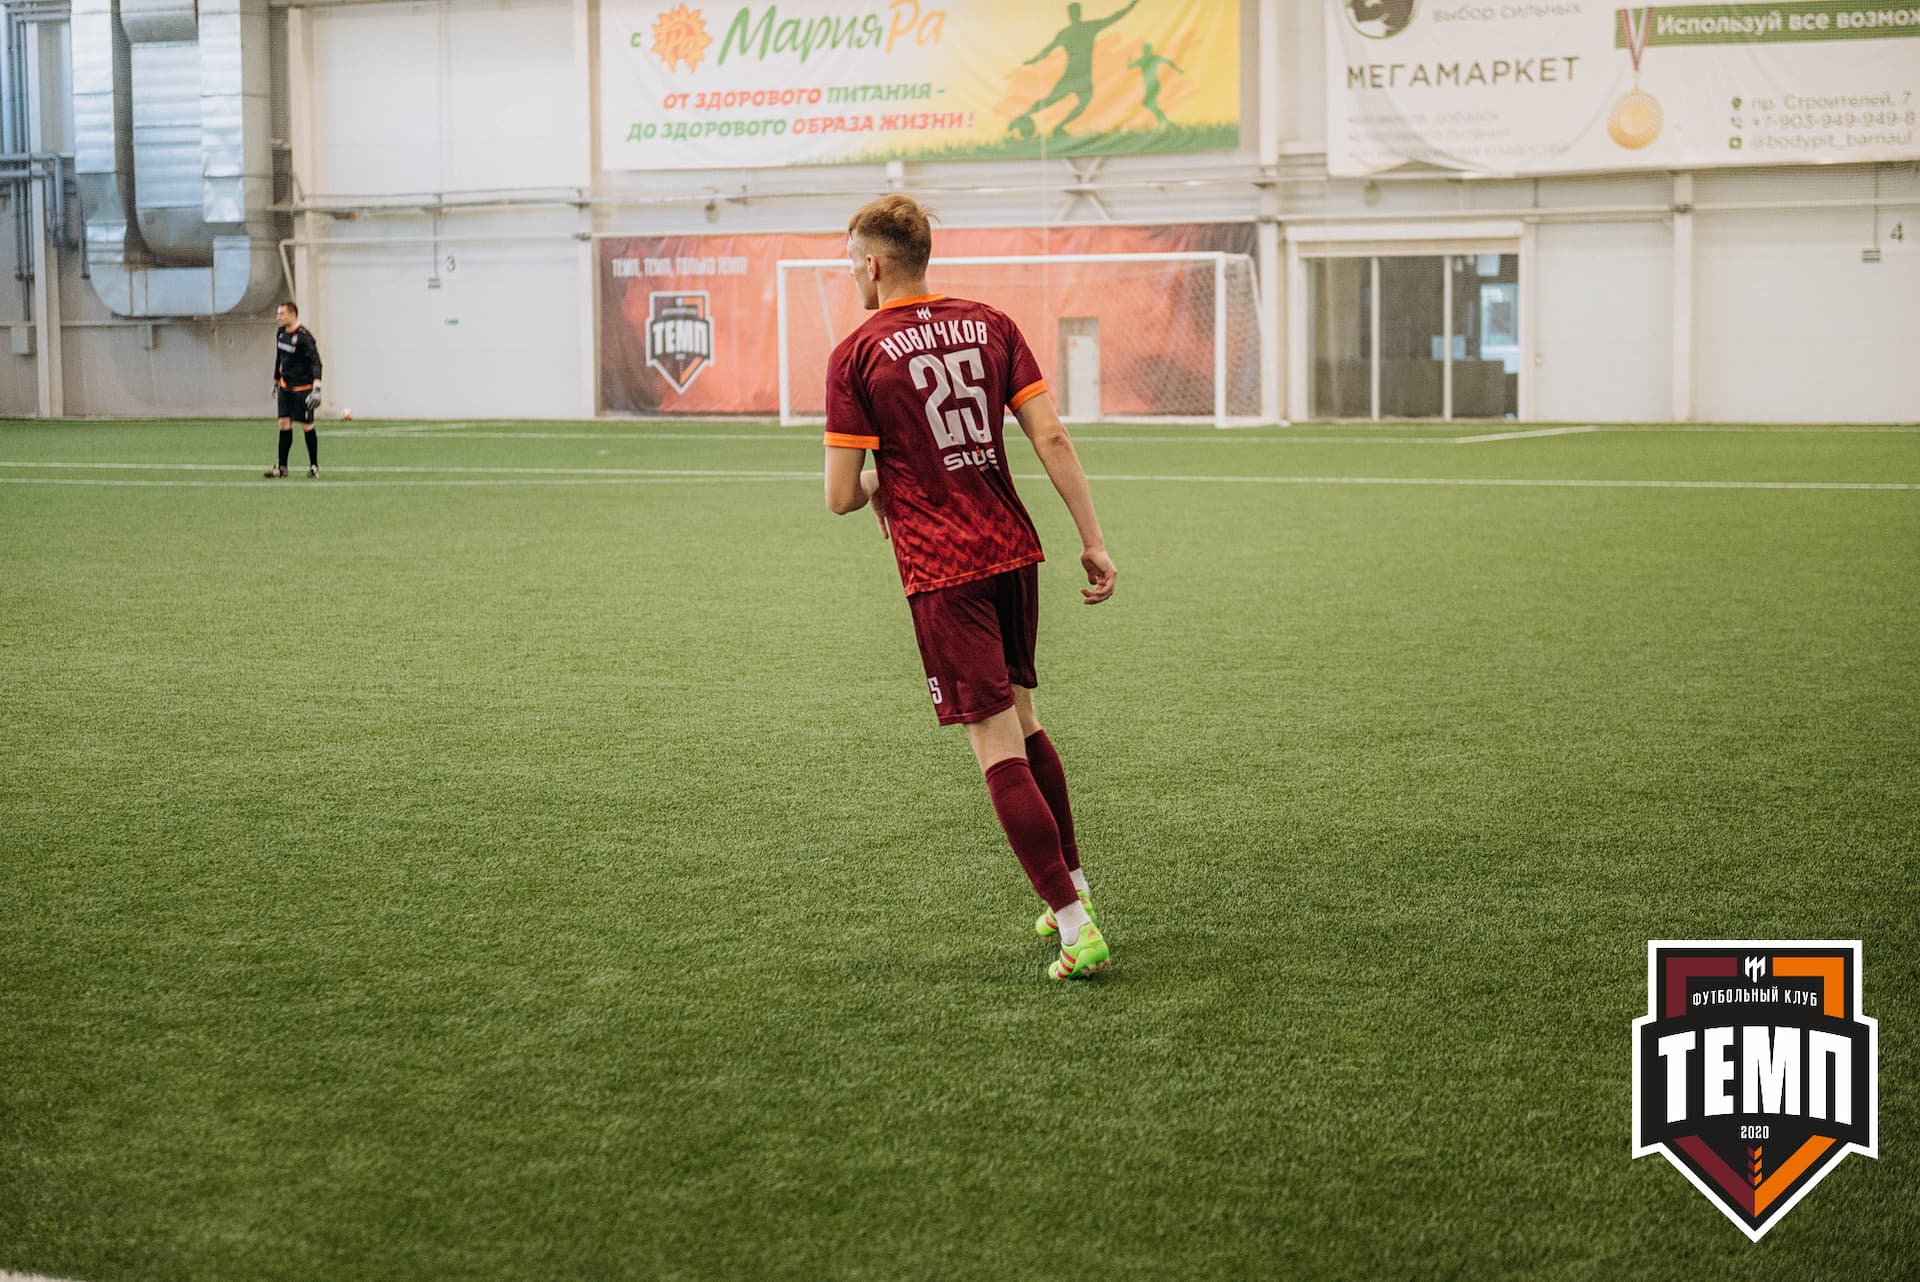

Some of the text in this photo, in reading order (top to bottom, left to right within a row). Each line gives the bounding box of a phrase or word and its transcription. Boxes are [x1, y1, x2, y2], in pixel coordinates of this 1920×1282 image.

[1656, 9, 1783, 36] Используй
[1789, 12, 1830, 31] все
[1346, 55, 1581, 89] МЕГАМАРКЕТ
[663, 92, 690, 110] ОТ
[694, 88, 822, 112] ЗДОРОВОГО
[827, 82, 932, 104] ПИТАНИЯ
[626, 121, 657, 143] ДО
[660, 118, 787, 142] ЗДОРОВОГО
[791, 114, 874, 135] ОБРАЗА
[1889, 222, 1904, 242] 4
[446, 255, 457, 273] 3
[651, 319, 709, 356] ТЕМП
[879, 319, 988, 362] НОВИЧКОВ
[908, 347, 993, 450] 25
